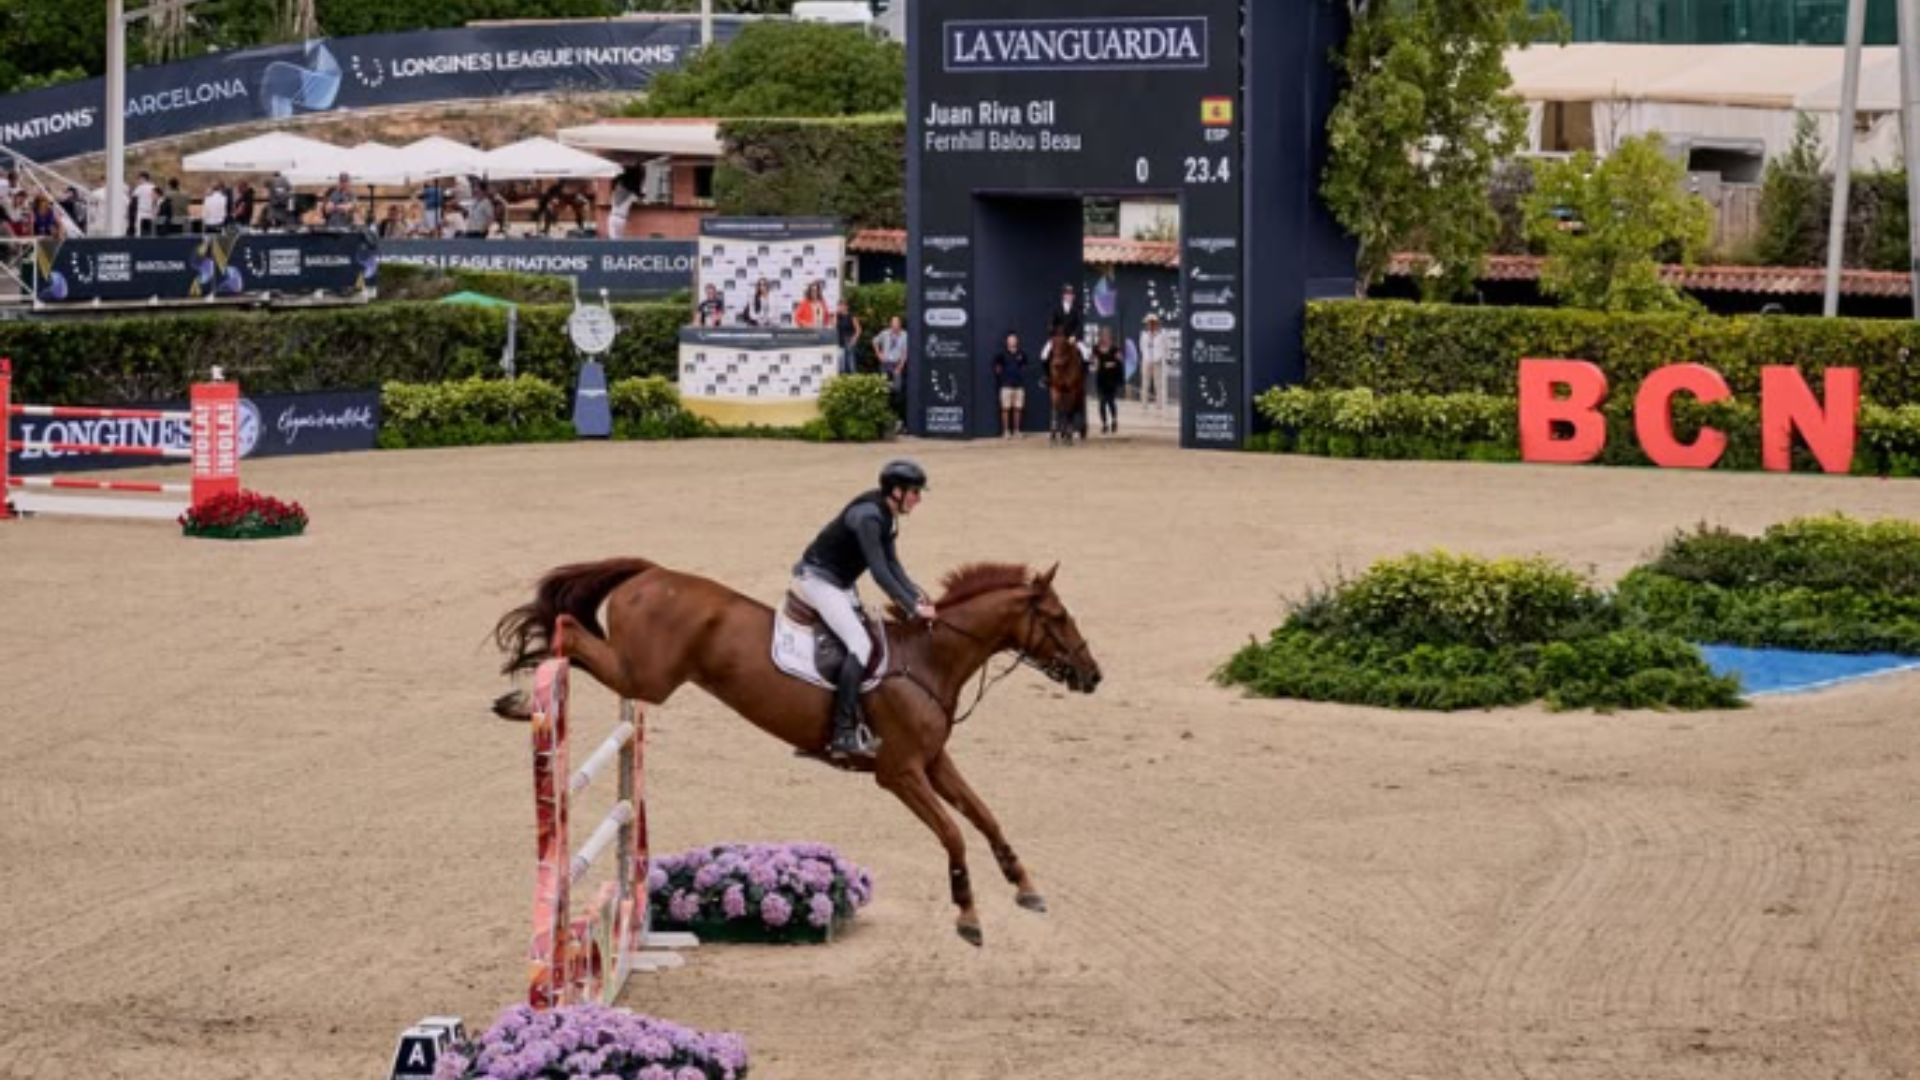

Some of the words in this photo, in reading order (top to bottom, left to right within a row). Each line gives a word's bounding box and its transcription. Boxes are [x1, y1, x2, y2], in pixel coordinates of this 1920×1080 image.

[954, 30, 994, 61] LA
[993, 26, 1200, 60] VANGUARDIA
[392, 52, 492, 77] LONGINES
[496, 48, 573, 71] LEAGUE
[584, 45, 675, 65] NATIONS
[123, 78, 248, 118] ARCELONA
[4, 108, 94, 143] NATIONS
[925, 101, 973, 125] Juan
[979, 100, 1022, 125] Riva
[1027, 99, 1055, 125] Gil
[925, 129, 986, 150] Fernhill
[989, 129, 1036, 150] Balou
[1040, 129, 1082, 150] Beau
[1204, 128, 1230, 141] ESP
[1136, 156, 1149, 183] 0
[1184, 156, 1231, 183] 23.4
[515, 254, 588, 271] NATIONS
[1518, 357, 1861, 473] BCN
[19, 417, 192, 458] LONGINES
[408, 1042, 425, 1066] A
